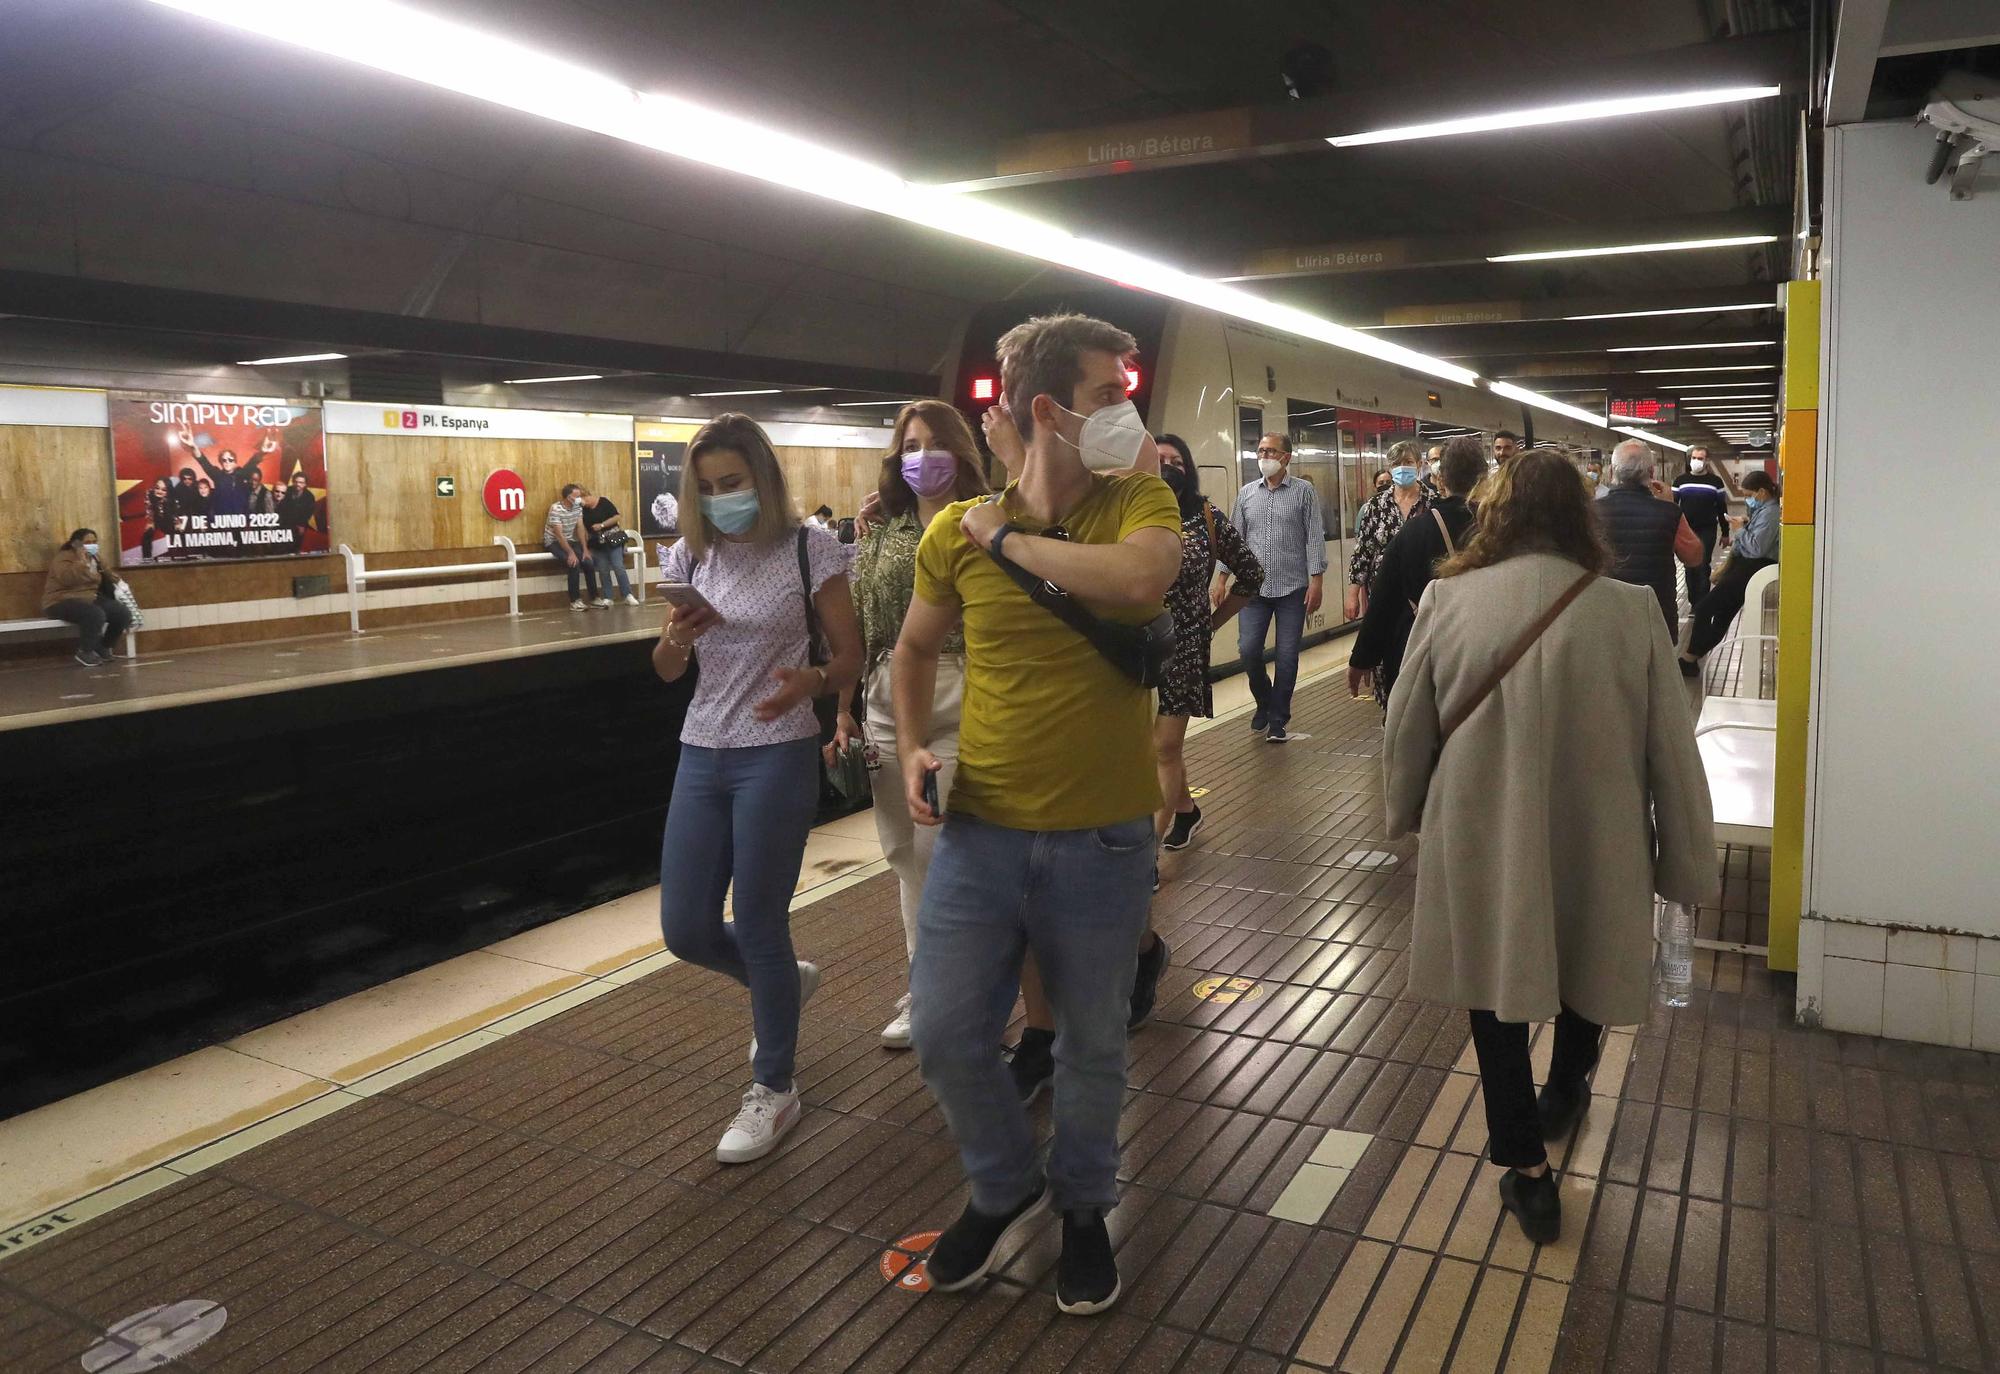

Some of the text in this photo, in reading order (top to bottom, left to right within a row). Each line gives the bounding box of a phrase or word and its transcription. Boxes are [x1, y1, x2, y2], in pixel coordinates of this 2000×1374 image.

[150, 402, 292, 427] SIMPLY RED
[423, 414, 438, 428] Pl.
[441, 416, 489, 431] Espanya
[499, 487, 525, 511] m
[191, 515, 208, 530] DE
[211, 514, 246, 529] JUNIO
[249, 512, 280, 527] 2022
[166, 529, 294, 548] LA MARINA, VALENCIA
